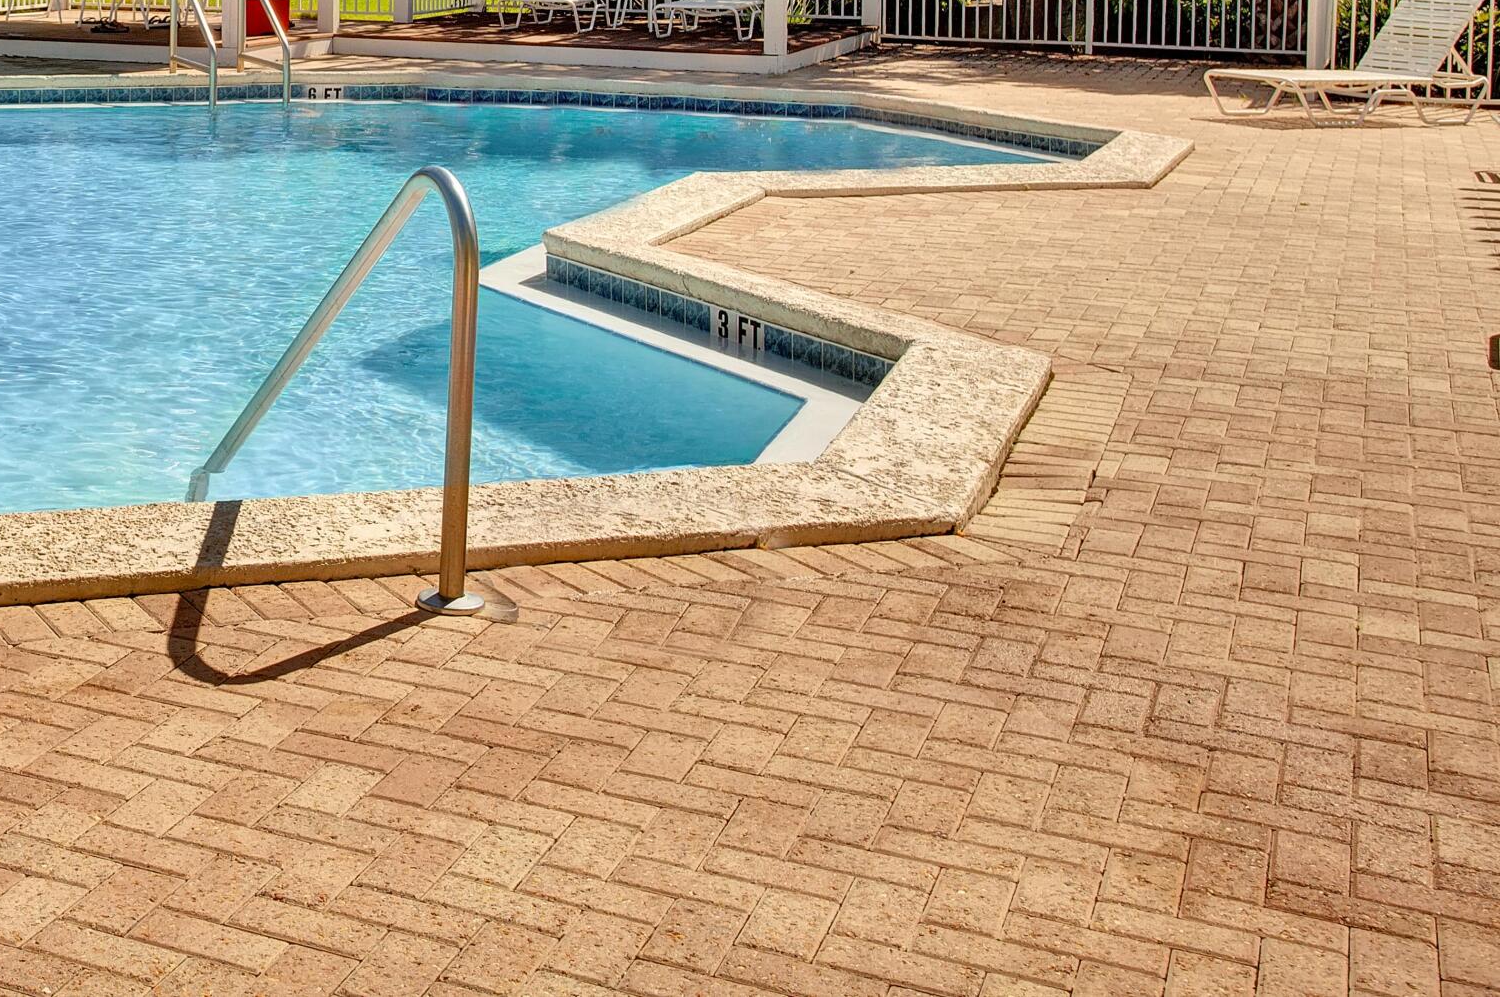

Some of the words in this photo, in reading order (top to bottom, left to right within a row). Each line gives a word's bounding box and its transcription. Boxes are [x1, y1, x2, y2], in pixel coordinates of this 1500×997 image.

[308, 87, 317, 99] 6
[324, 87, 341, 99] FT
[717, 309, 729, 339] 3
